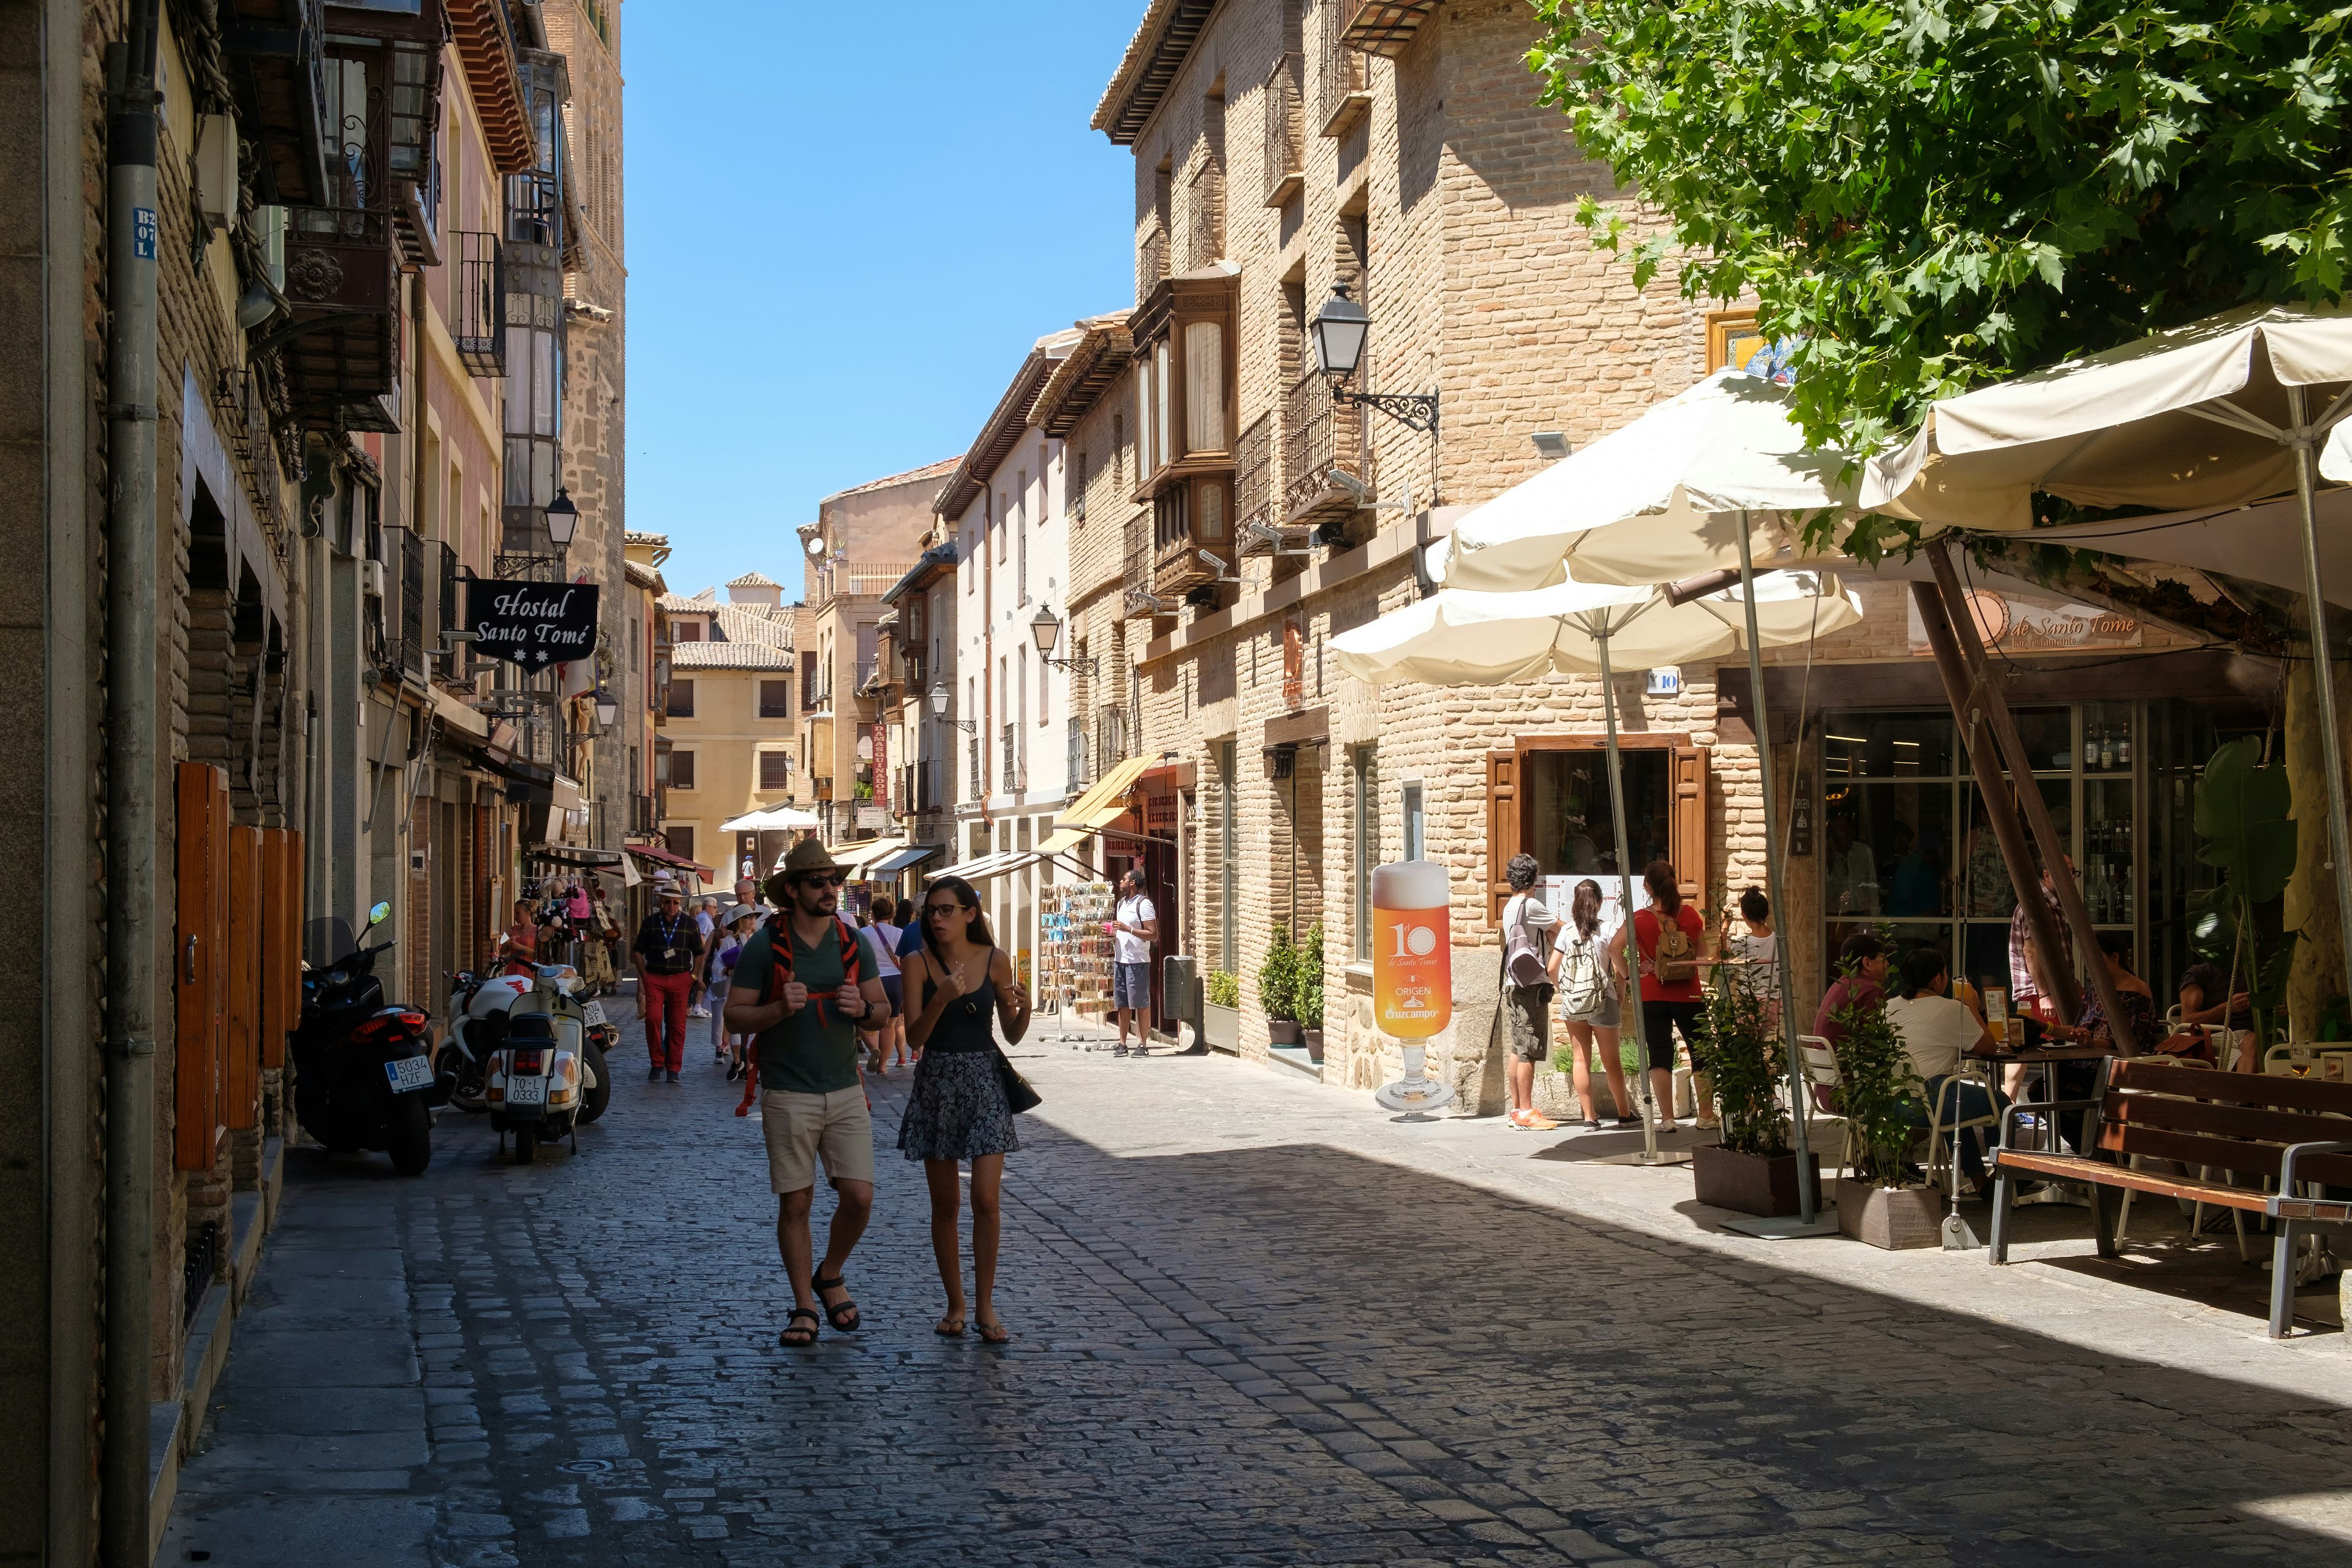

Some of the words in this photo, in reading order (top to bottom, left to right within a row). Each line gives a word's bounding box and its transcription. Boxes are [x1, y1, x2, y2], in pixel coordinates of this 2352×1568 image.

[494, 587, 575, 618] Hostal
[2010, 614, 2029, 636] de
[2034, 616, 2084, 636] Santo
[2090, 614, 2135, 633] Tome
[475, 622, 527, 642] Santo
[535, 624, 590, 644] Tomé
[2011, 638, 2026, 647] bar
[2029, 636, 2078, 647] restaurante
[1661, 676, 1677, 688] 10
[873, 726, 886, 794] DAMASQUINADOS
[1794, 799, 1810, 809] ORIGEN
[1387, 957, 1395, 967] de
[1396, 958, 1417, 967] Santo
[1418, 957, 1438, 966] Tomé
[1395, 987, 1431, 996] ORIGEN
[1385, 1009, 1436, 1020] Cruzcampo
[397, 1058, 428, 1074] 5034
[400, 1071, 421, 1086] HZF
[513, 1090, 539, 1101] 0333
